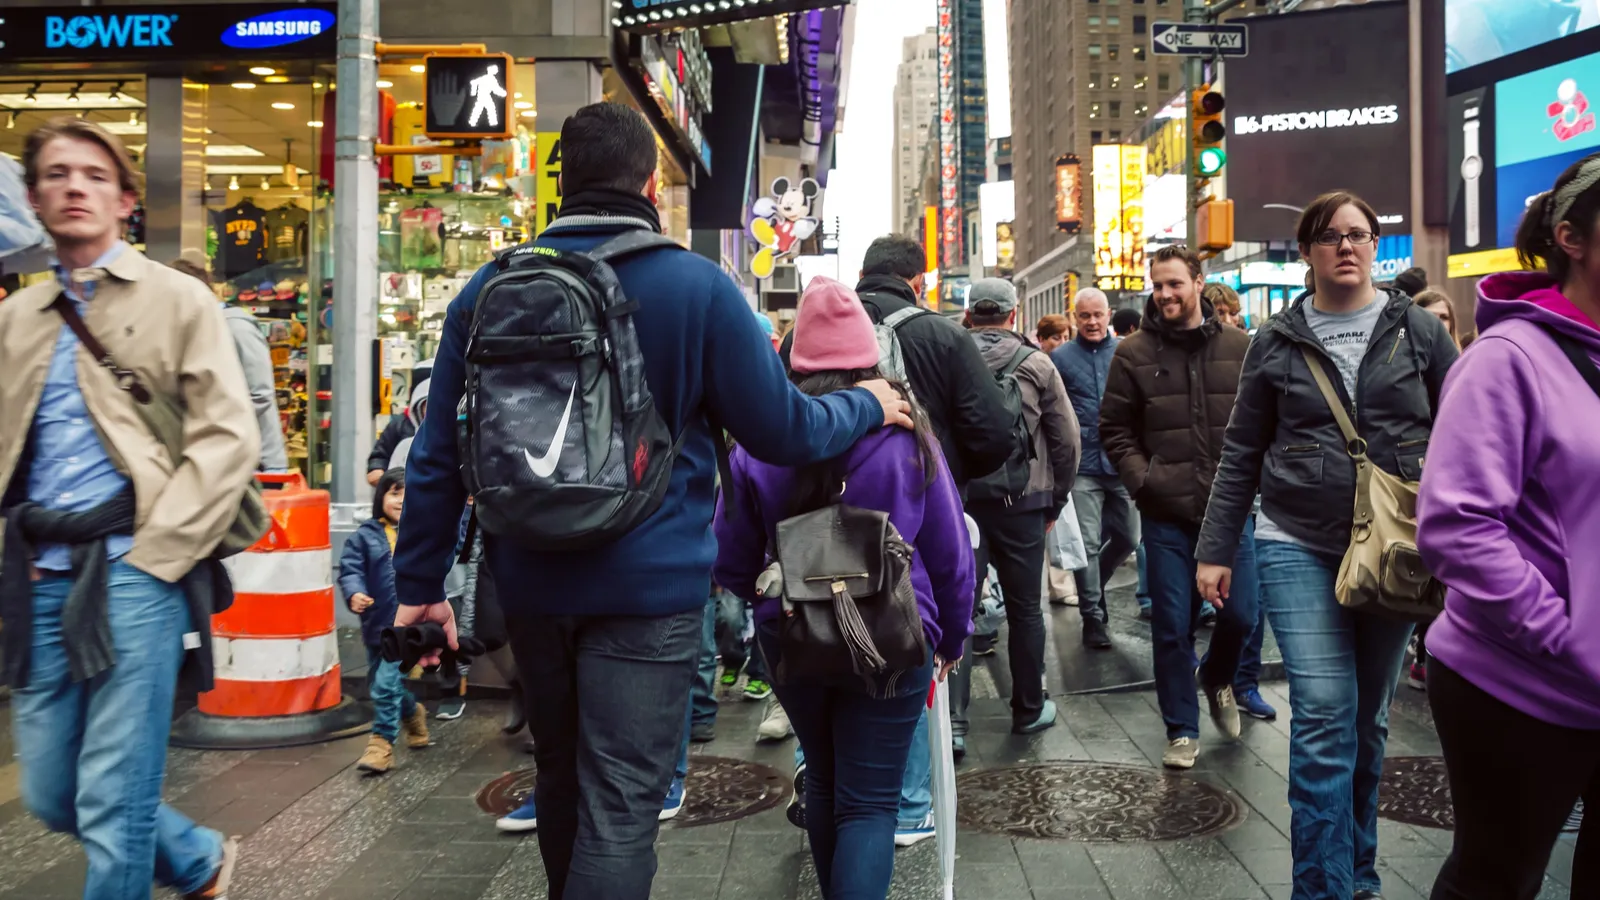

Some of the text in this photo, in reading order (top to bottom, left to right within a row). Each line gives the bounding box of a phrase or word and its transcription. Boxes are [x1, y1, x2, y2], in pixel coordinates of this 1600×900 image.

[45, 14, 174, 48] BOWER
[235, 20, 321, 37] SAMSUNG
[1164, 33, 1238, 46] ONE WAY
[1326, 104, 1399, 128] BRAKES
[1324, 339, 1353, 347] PERIAL
